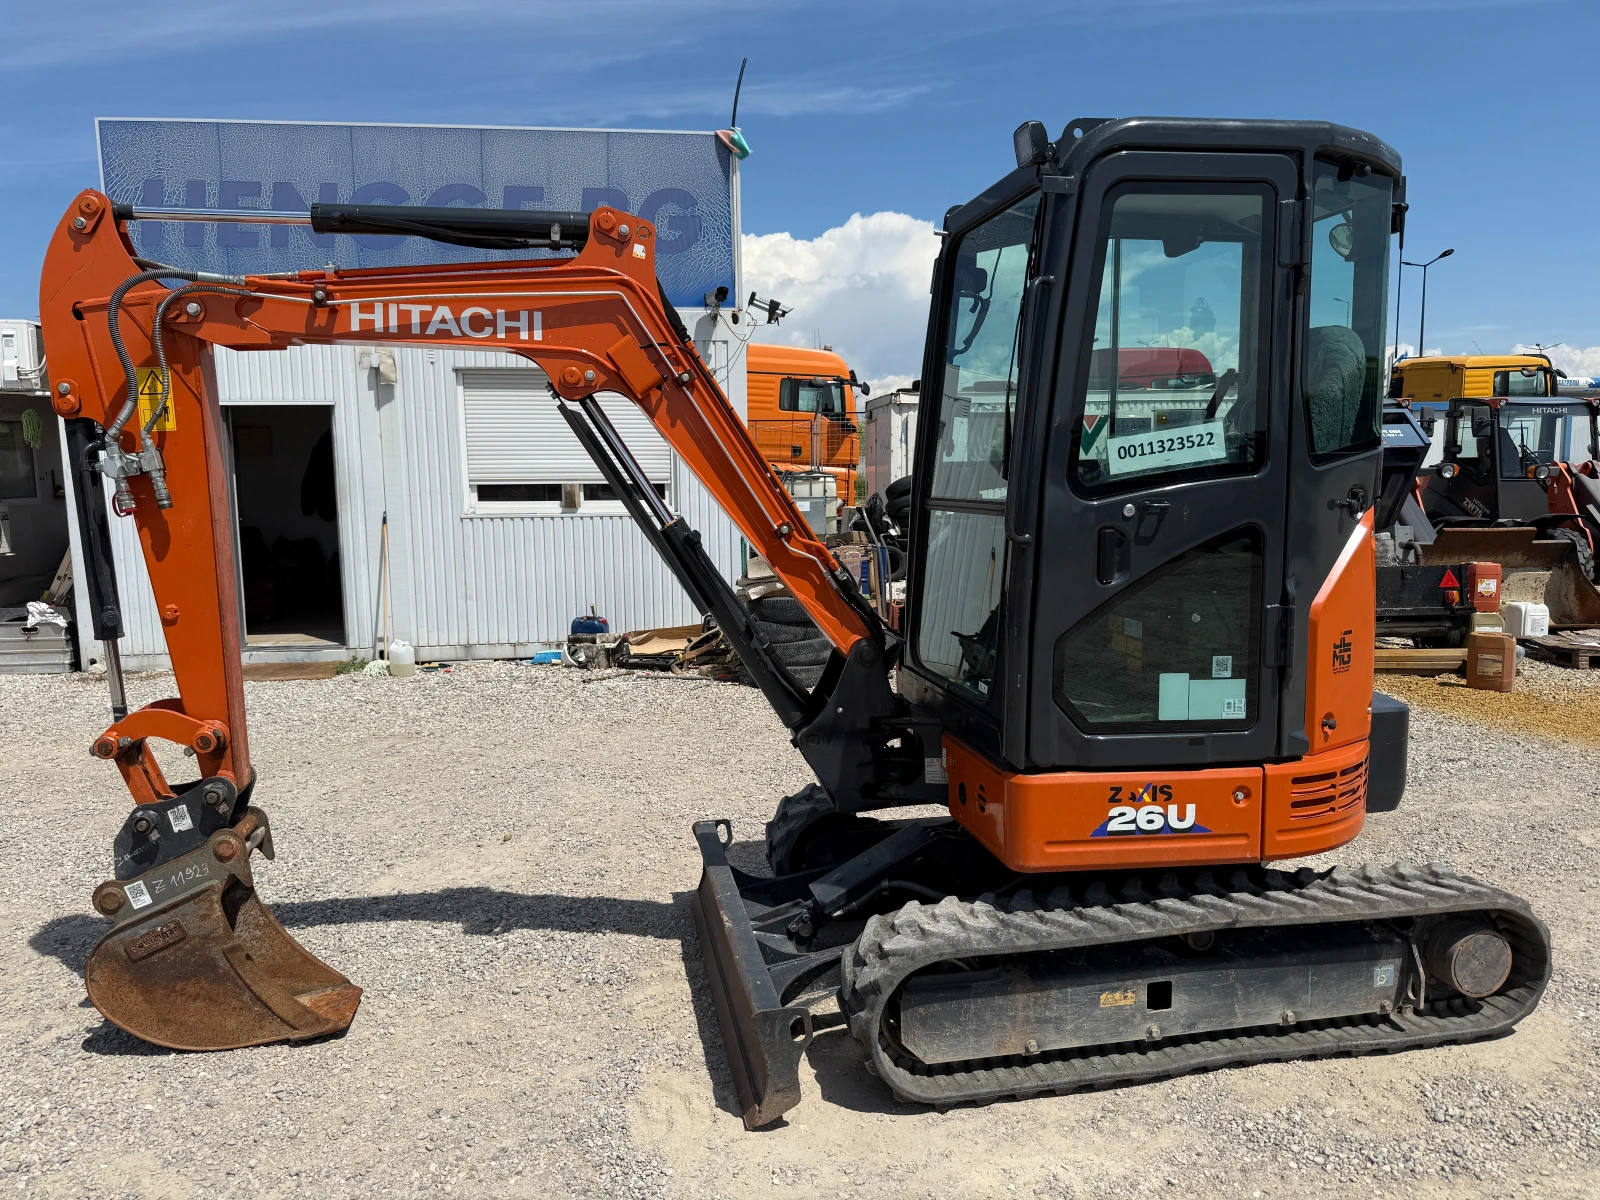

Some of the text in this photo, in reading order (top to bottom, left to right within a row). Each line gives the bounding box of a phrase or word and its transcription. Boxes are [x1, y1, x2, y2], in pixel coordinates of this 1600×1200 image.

[350, 302, 543, 341] HITACHI
[1117, 431, 1215, 460] 0011323522
[1106, 803, 1196, 836] 26U
[151, 879, 167, 894] Z
